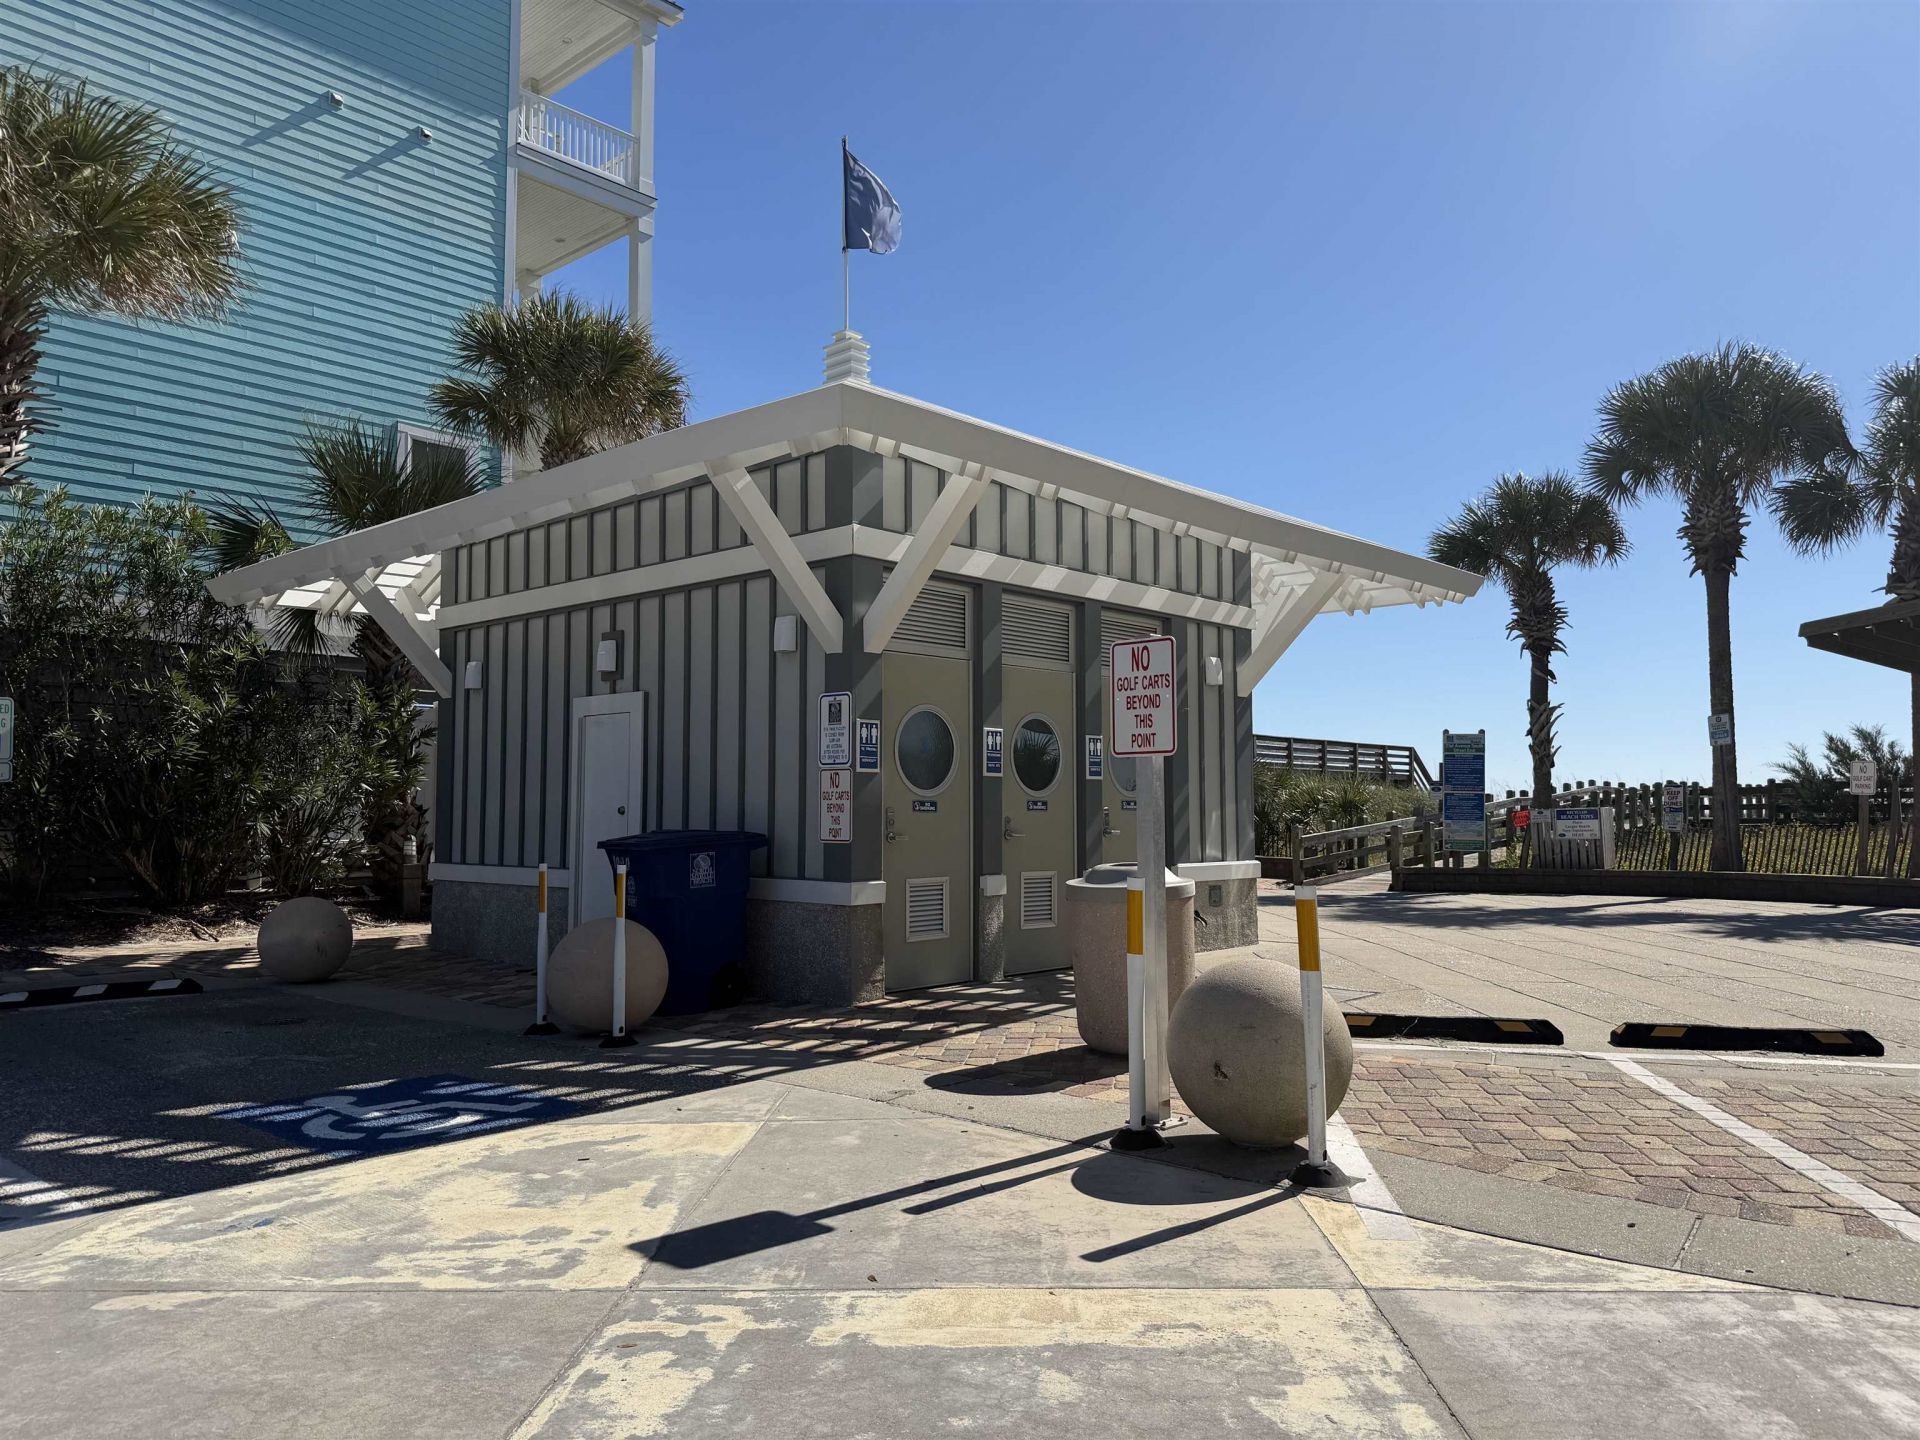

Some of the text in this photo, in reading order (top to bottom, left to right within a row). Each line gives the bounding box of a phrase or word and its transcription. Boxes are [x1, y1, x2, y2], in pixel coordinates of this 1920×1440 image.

[1131, 645, 1150, 672] NO
[1116, 673, 1171, 692] GOLF CARTS
[1126, 693, 1161, 710] BEYOND
[1134, 713, 1153, 729] THIS
[1131, 732, 1156, 748] POINT
[1859, 765, 1868, 774] NO
[829, 771, 840, 789] NO
[822, 790, 850, 800] GOLF CARTS
[826, 803, 845, 813] BEYOND
[830, 815, 841, 826] THIS
[828, 827, 842, 838] POINT
